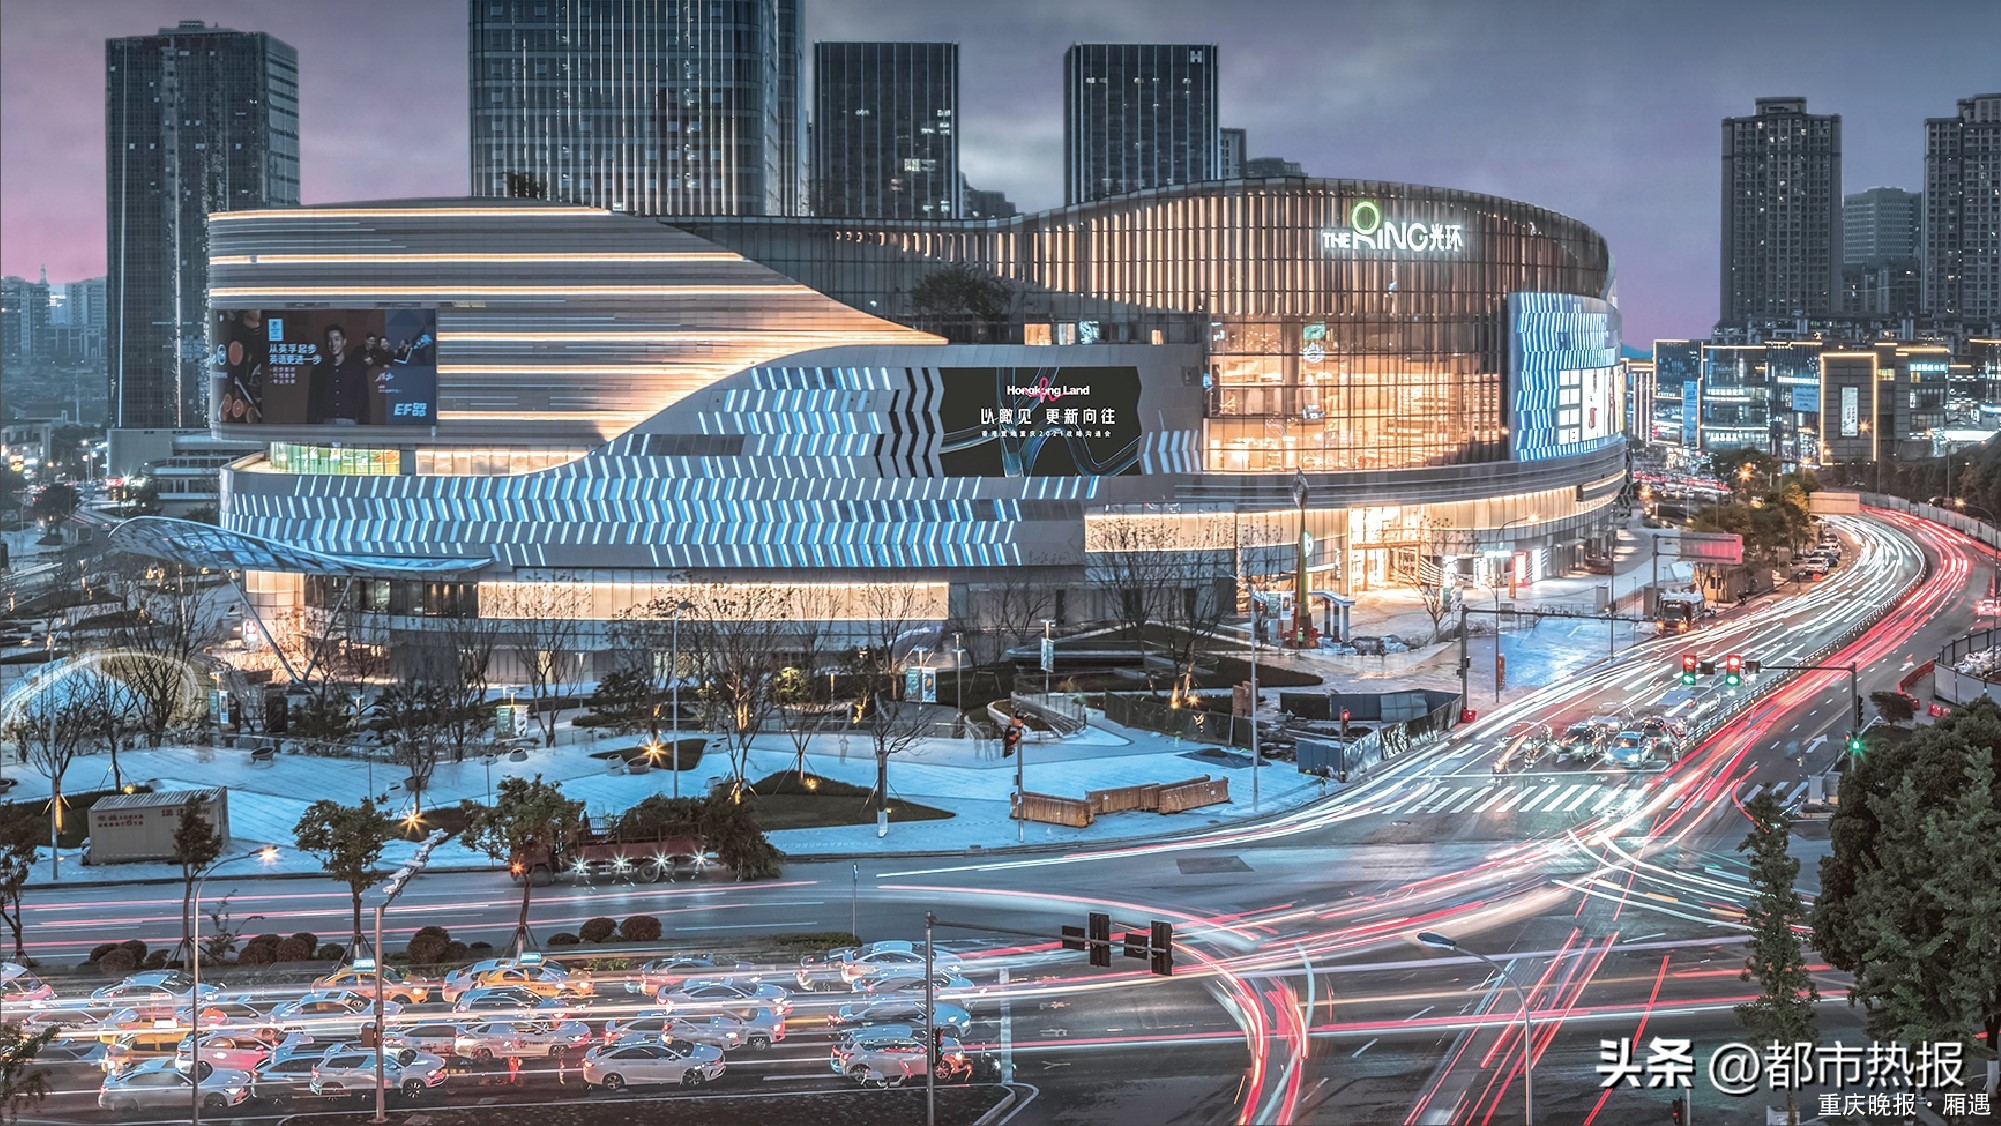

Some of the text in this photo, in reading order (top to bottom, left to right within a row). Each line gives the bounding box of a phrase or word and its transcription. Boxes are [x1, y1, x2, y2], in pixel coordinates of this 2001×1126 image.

[1323, 201, 1463, 252] THE RING 光环
[1063, 385, 1090, 396] Land
[1045, 407, 1116, 425] 更新向往
